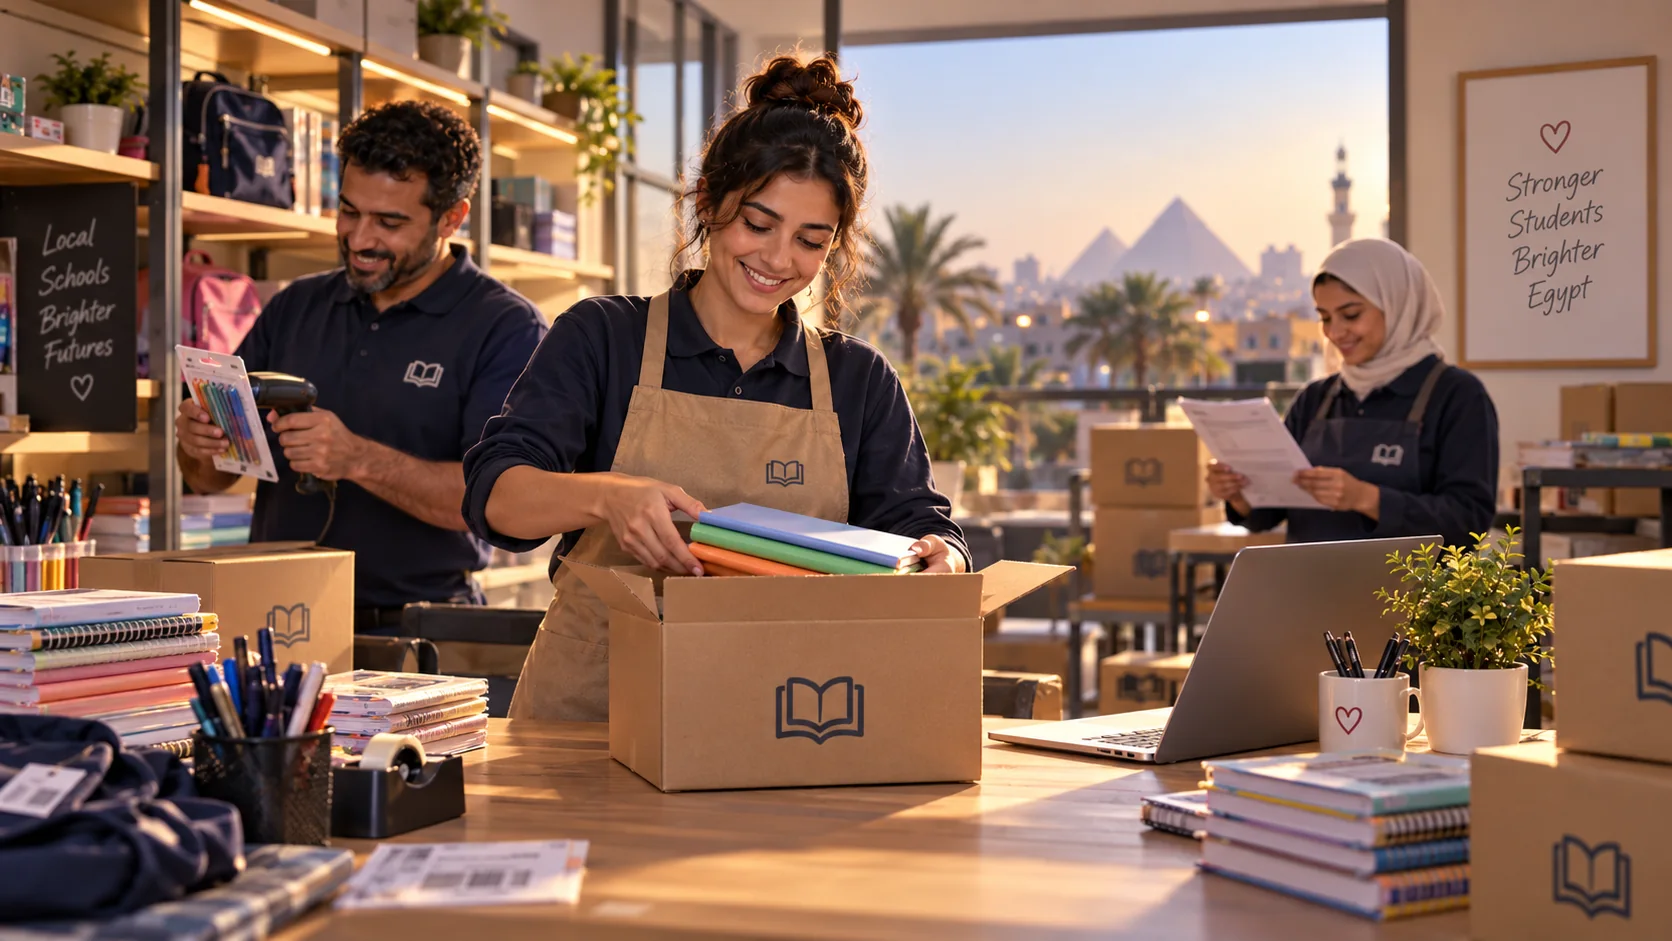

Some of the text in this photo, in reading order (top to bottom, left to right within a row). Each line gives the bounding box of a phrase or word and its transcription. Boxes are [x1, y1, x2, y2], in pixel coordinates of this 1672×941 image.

[1505, 168, 1604, 202] Stronger
[42, 217, 96, 257] Local
[1508, 199, 1604, 239] Students
[38, 257, 110, 296] Schools
[1512, 239, 1605, 278] Brighter
[1528, 274, 1593, 316] Egypt
[39, 299, 116, 337] Brighter
[44, 337, 113, 370] Futures
